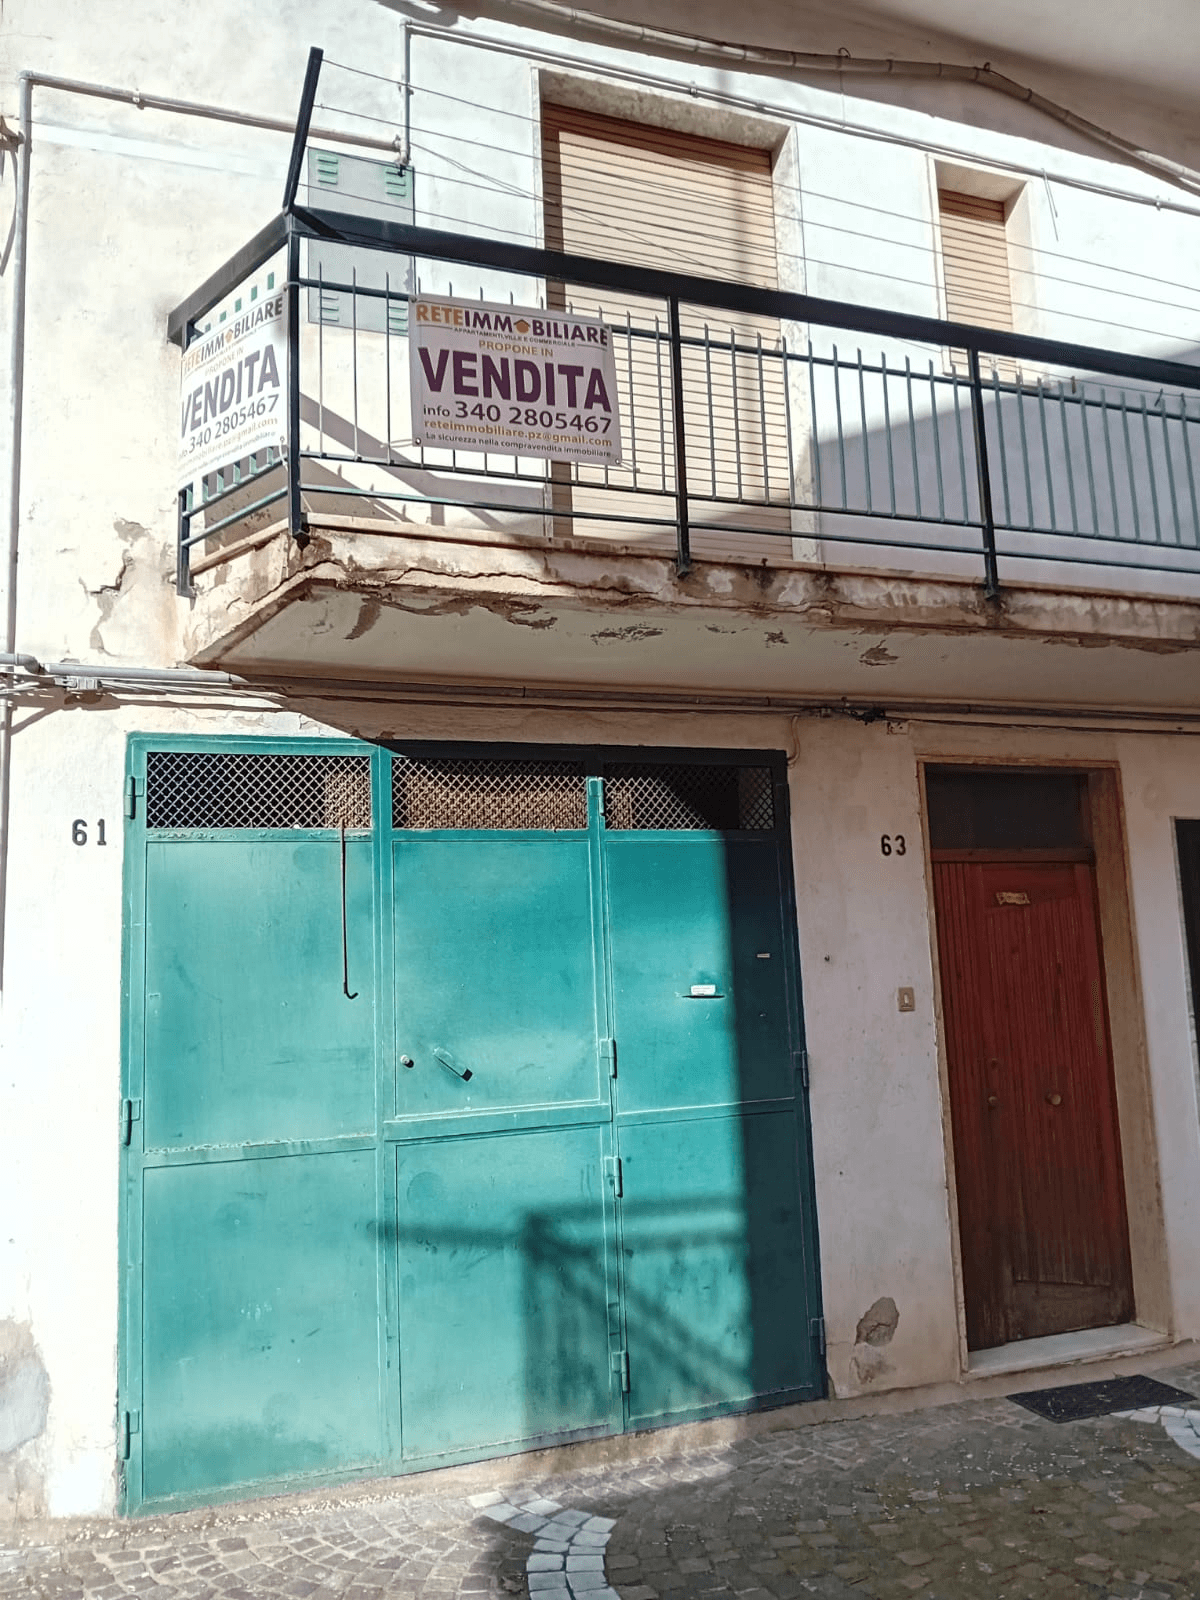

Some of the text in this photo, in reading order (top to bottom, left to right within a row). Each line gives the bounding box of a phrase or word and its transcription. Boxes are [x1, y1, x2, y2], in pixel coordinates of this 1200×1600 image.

[479, 340, 553, 357] PROPONE IN
[182, 344, 280, 438] VENDITA
[418, 347, 611, 413] VENDITA
[189, 427, 211, 454] 340
[215, 394, 279, 439] 2805467
[424, 401, 611, 434] info 340 2805467
[424, 420, 612, 447] reteimmobiliare.pz@gmail.com
[438, 433, 477, 443] sicurezza
[479, 437, 499, 446] nella
[501, 440, 562, 452] compravendita
[563, 446, 611, 457] immobiliare
[72, 819, 107, 846] 61
[881, 834, 906, 856] 63
